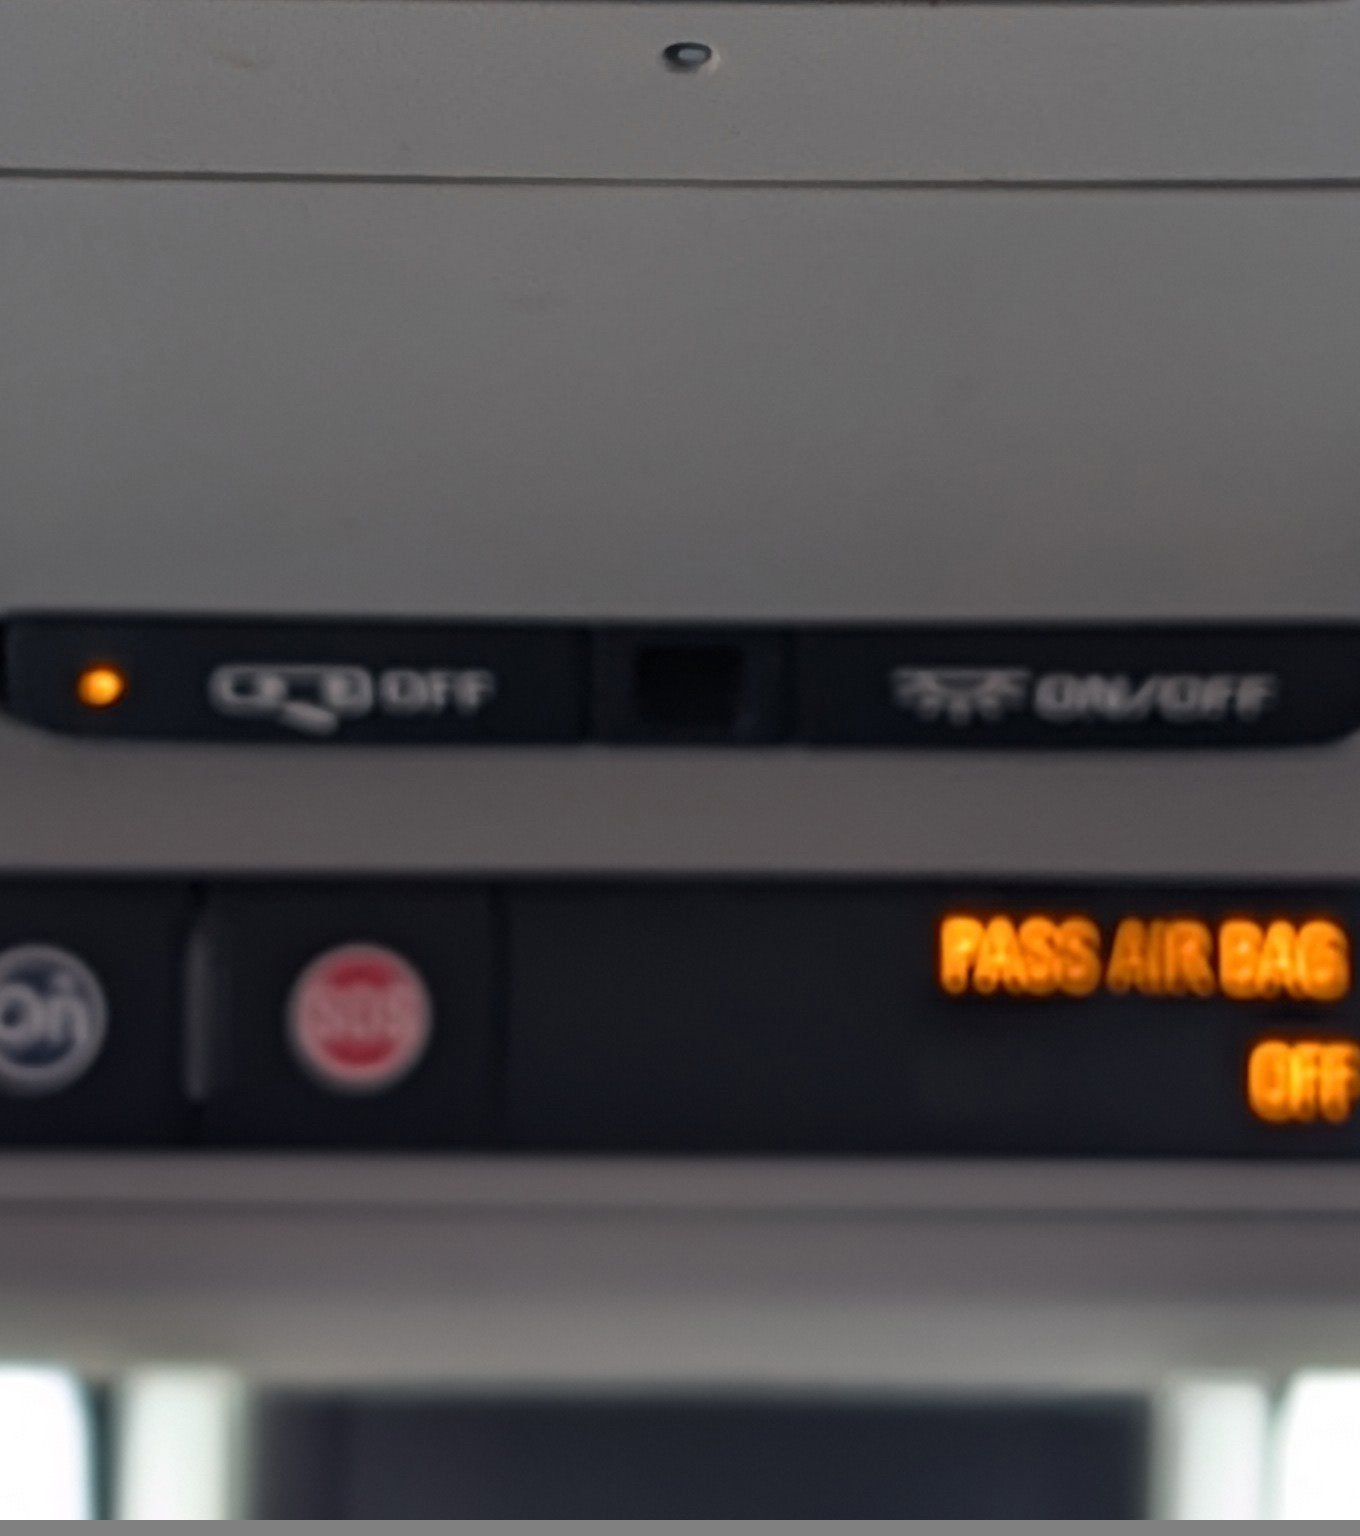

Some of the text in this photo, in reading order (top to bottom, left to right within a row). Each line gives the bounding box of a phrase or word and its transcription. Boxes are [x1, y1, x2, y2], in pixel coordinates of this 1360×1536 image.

[378, 669, 493, 711] OFF
[1034, 674, 1272, 717] ON/OFF
[940, 915, 1350, 999] PASS AIR BAG
